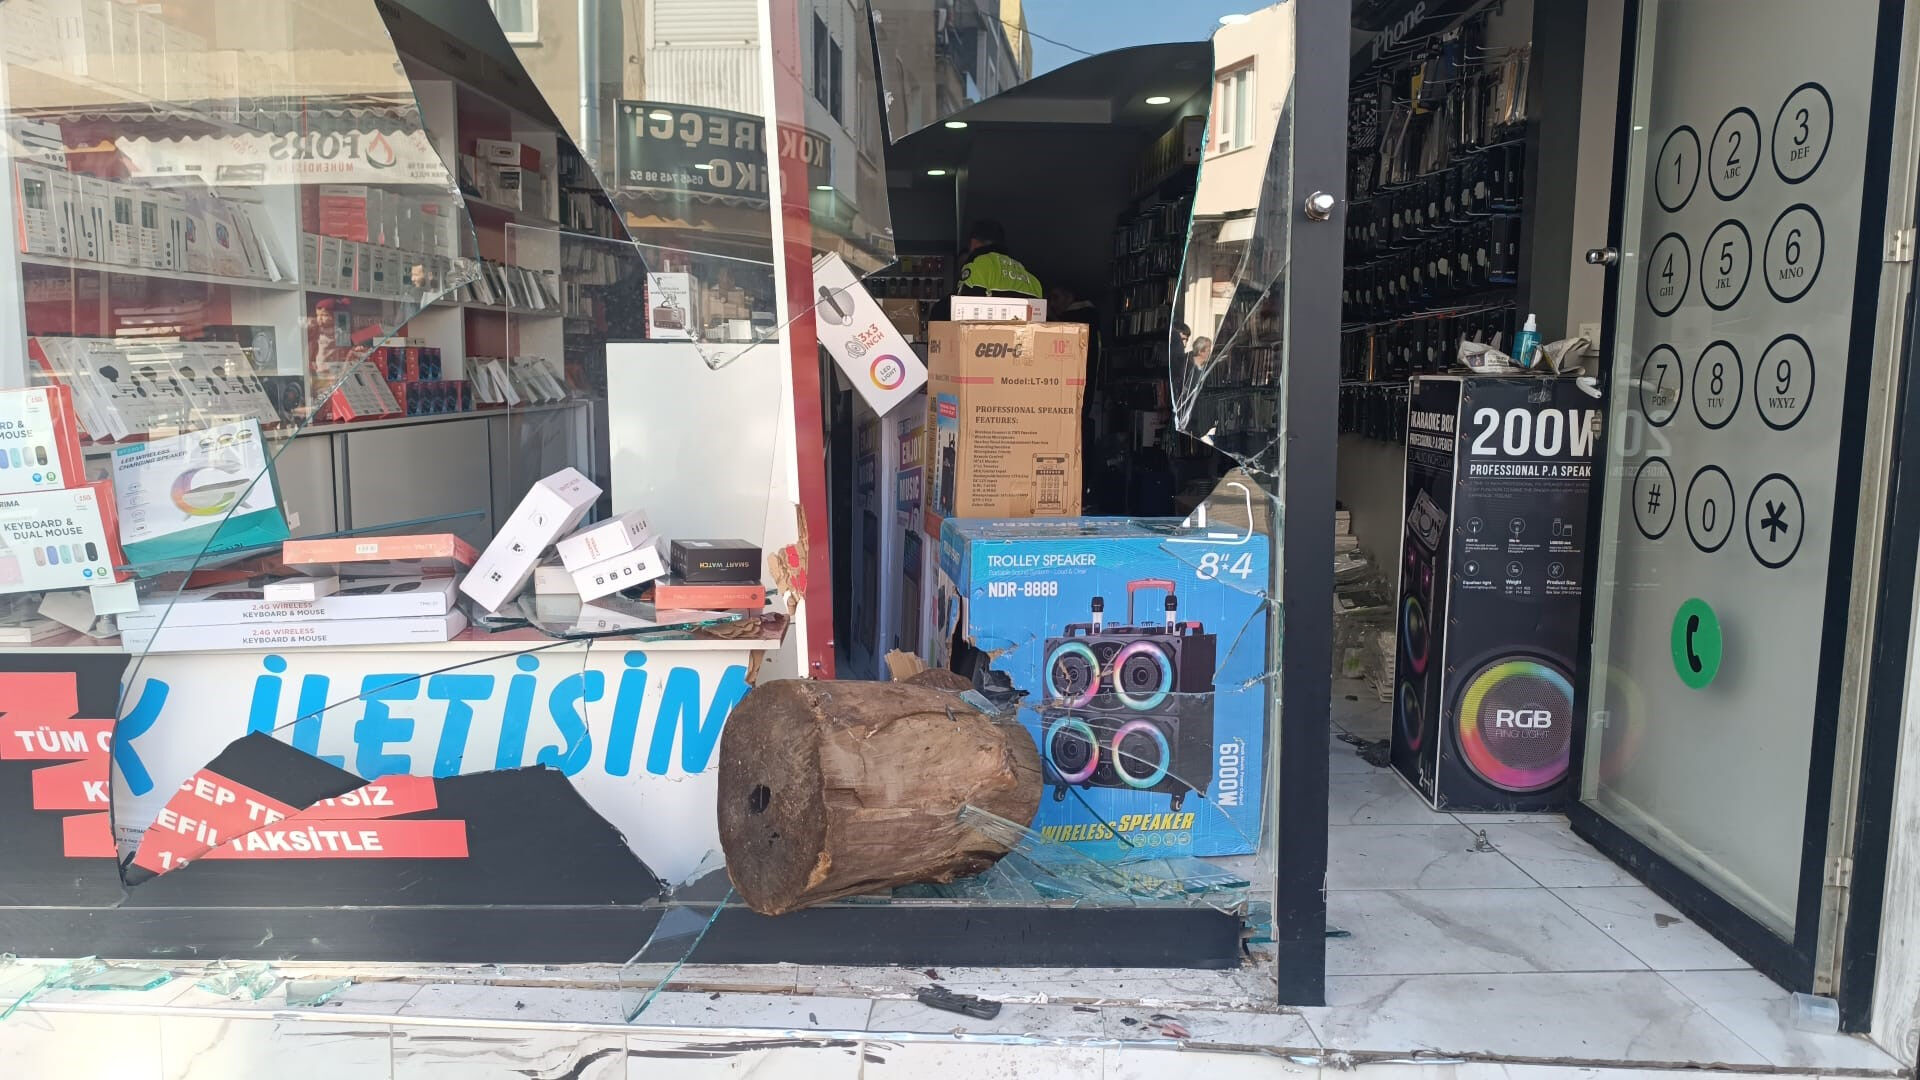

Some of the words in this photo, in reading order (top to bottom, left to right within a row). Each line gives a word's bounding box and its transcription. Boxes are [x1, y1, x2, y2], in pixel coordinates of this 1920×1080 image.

[1371, 0, 1426, 63] iPhone
[1793, 107, 1810, 146] 3
[1726, 130, 1742, 167] 2
[1789, 146, 1812, 162] DEF
[1673, 152, 1683, 185] 1
[1722, 166, 1743, 180] ABC
[1785, 228, 1802, 266] 6
[1719, 241, 1734, 276] 5
[1661, 252, 1675, 285] 4
[1778, 266, 1805, 281] MNO
[1715, 277, 1732, 290] JKL
[863, 331, 885, 350] INCH
[880, 365, 891, 376] LED
[1656, 363, 1669, 394] 7
[1710, 362, 1724, 396] 8
[1775, 359, 1793, 396] 9
[1000, 376, 1060, 386] Model:LT-910
[975, 405, 1036, 415] PROFESSIONAL
[1037, 406, 1074, 415] SPEAKER
[1768, 396, 1796, 410] WXYZ
[975, 416, 1019, 425] FEATURES:
[1470, 464, 1540, 477] PROFESSIONAL
[1542, 465, 1558, 477] P.A
[1702, 498, 1717, 533] 0
[4, 519, 62, 532] KEYBOARD
[66, 518, 74, 526] &
[13, 528, 43, 541] DUAL
[45, 526, 84, 538] MOUSE
[699, 561, 726, 569] WATCH
[988, 555, 1041, 567] TROLLEY
[1043, 553, 1097, 566] SPEAKER
[988, 581, 1058, 598] NDR-8888
[242, 610, 288, 618] KEYBOARD
[297, 608, 326, 616] MOUSE
[242, 636, 289, 644] KEYBOARD
[1495, 709, 1553, 729] RGB
[14, 726, 89, 753] TÜM
[1218, 743, 1239, 806] 6000W
[1040, 820, 1117, 843] WIRELESS
[1117, 812, 1195, 833] SPEAKER
